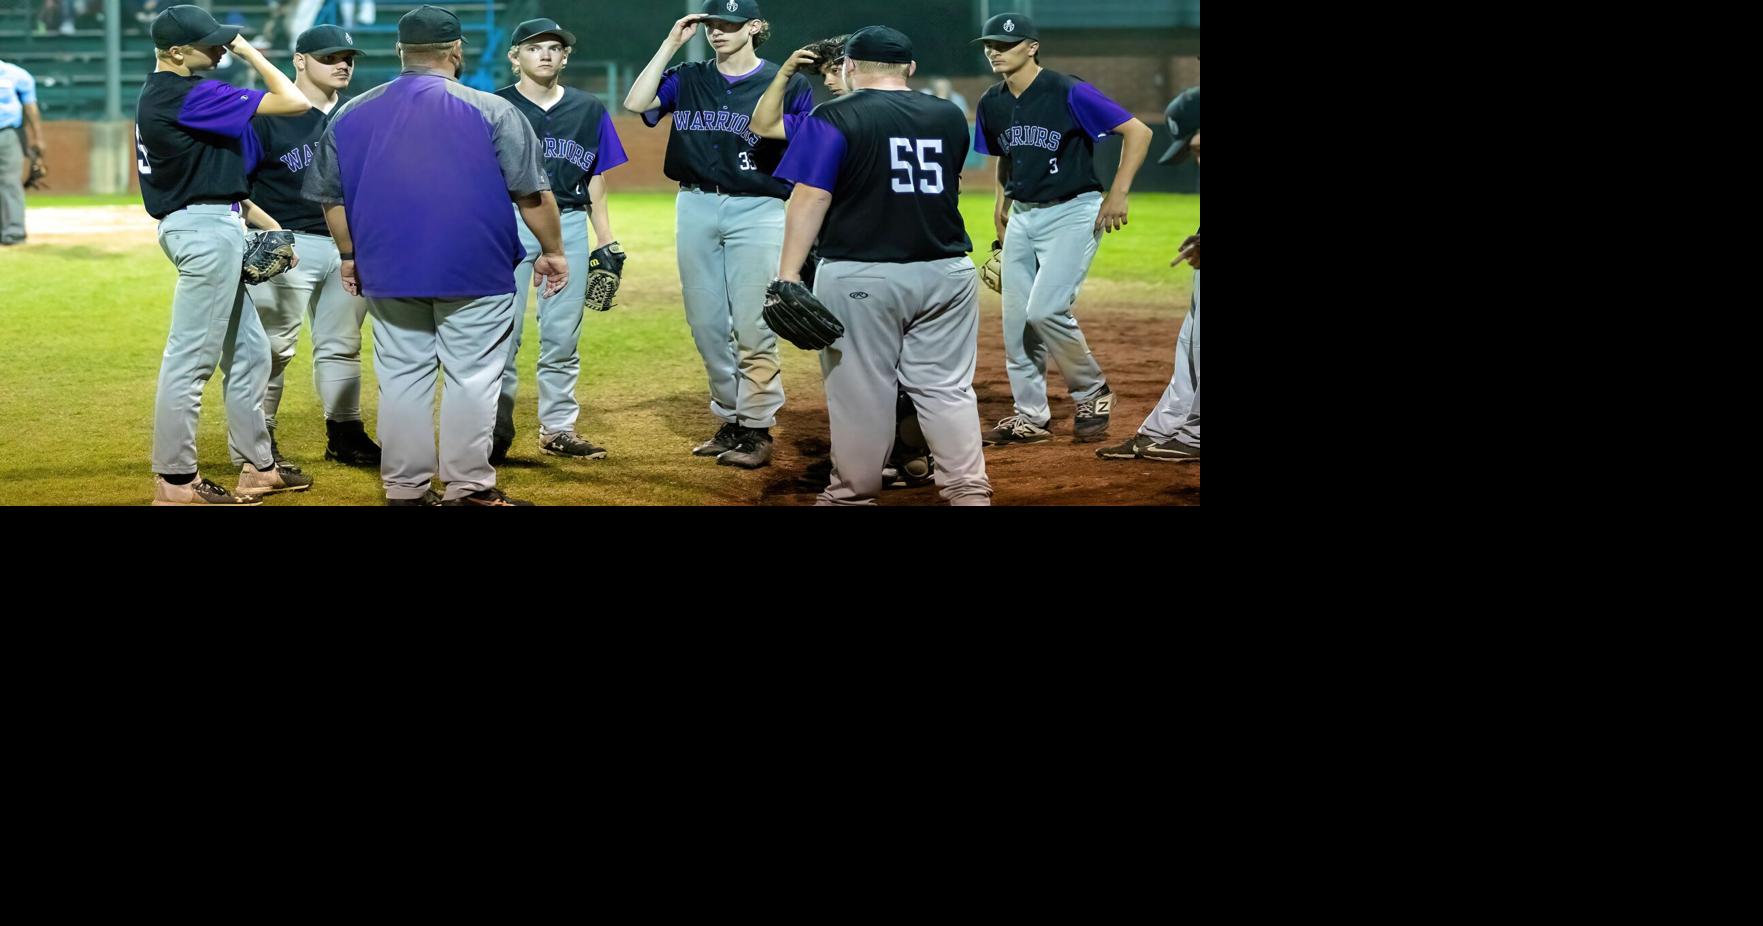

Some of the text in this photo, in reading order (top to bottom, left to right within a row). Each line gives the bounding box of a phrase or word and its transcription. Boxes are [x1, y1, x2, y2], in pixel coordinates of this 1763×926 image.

[541, 137, 595, 172] RIORS
[889, 137, 944, 193] 55
[1049, 157, 1059, 174] 3
